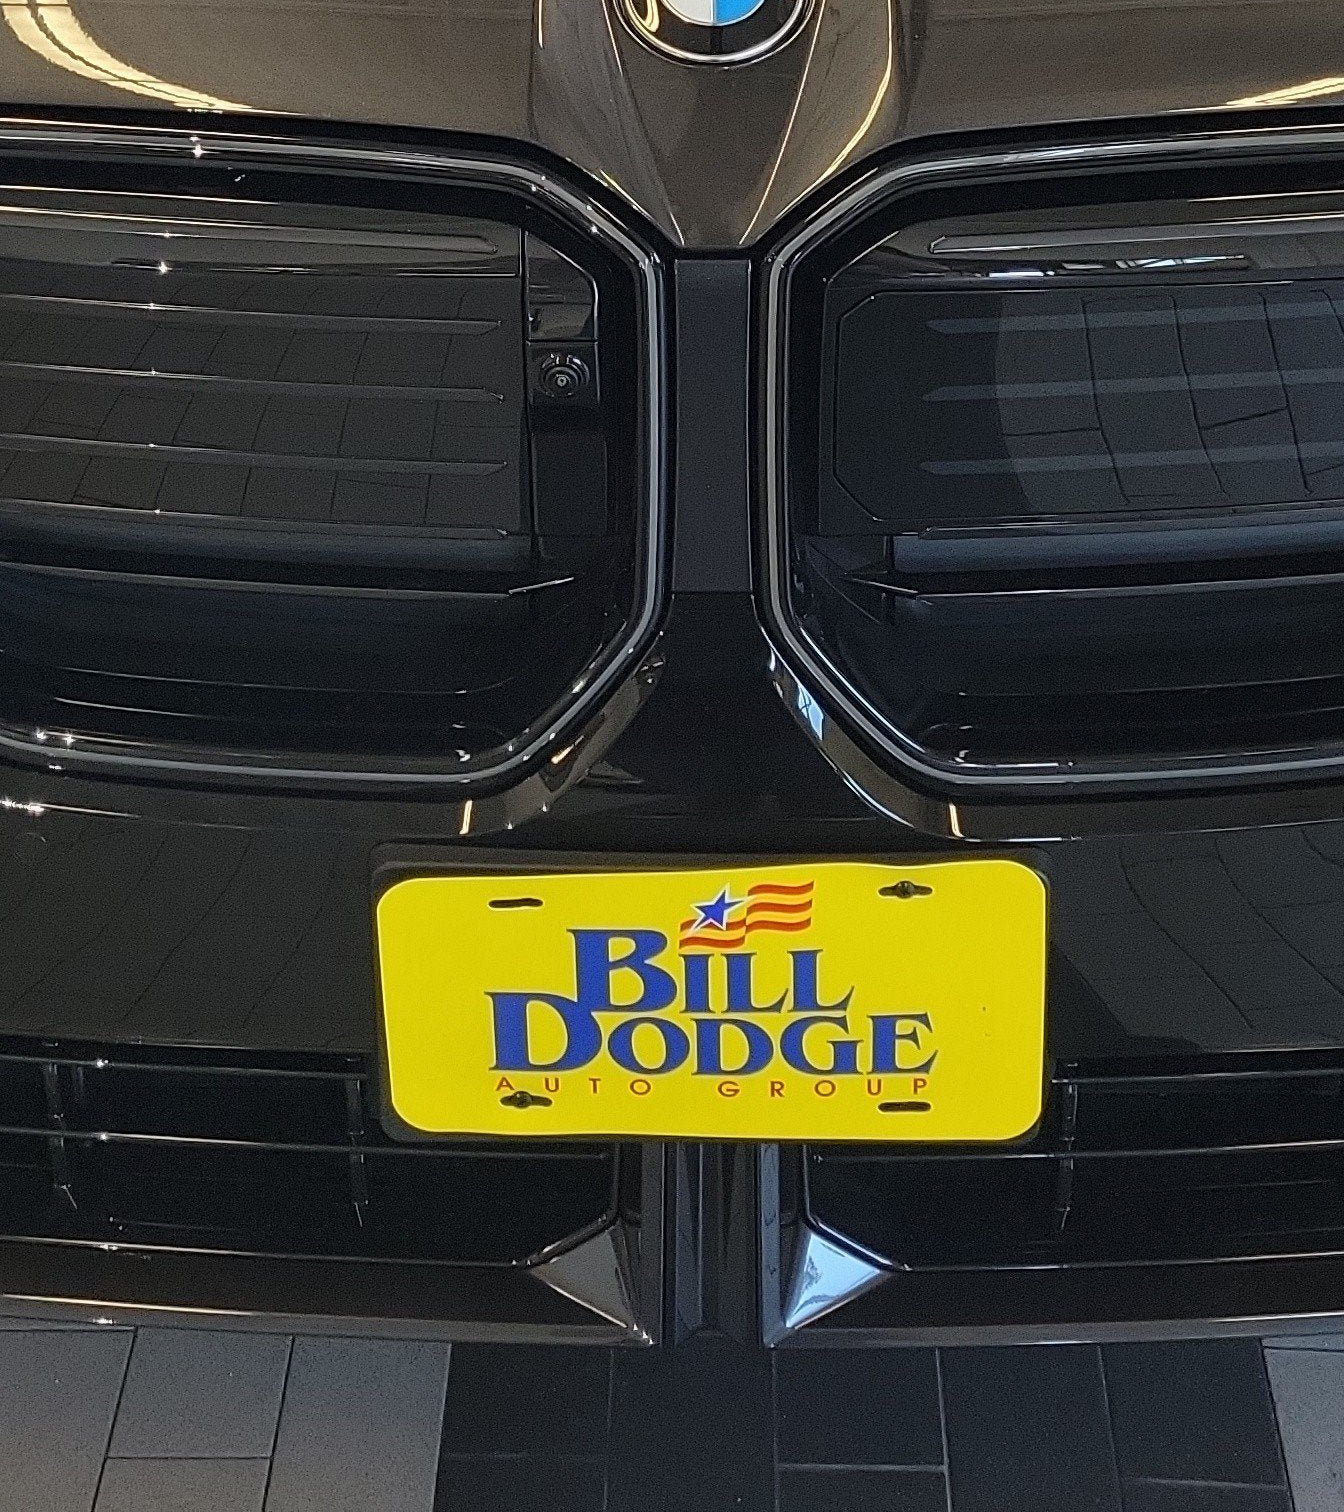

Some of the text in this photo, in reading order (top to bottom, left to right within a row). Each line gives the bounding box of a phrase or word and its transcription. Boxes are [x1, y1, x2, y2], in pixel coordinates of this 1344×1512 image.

[566, 927, 855, 1015] BILL
[483, 990, 939, 1077] DODGE
[494, 1076, 929, 1099] AUTO GROUP
